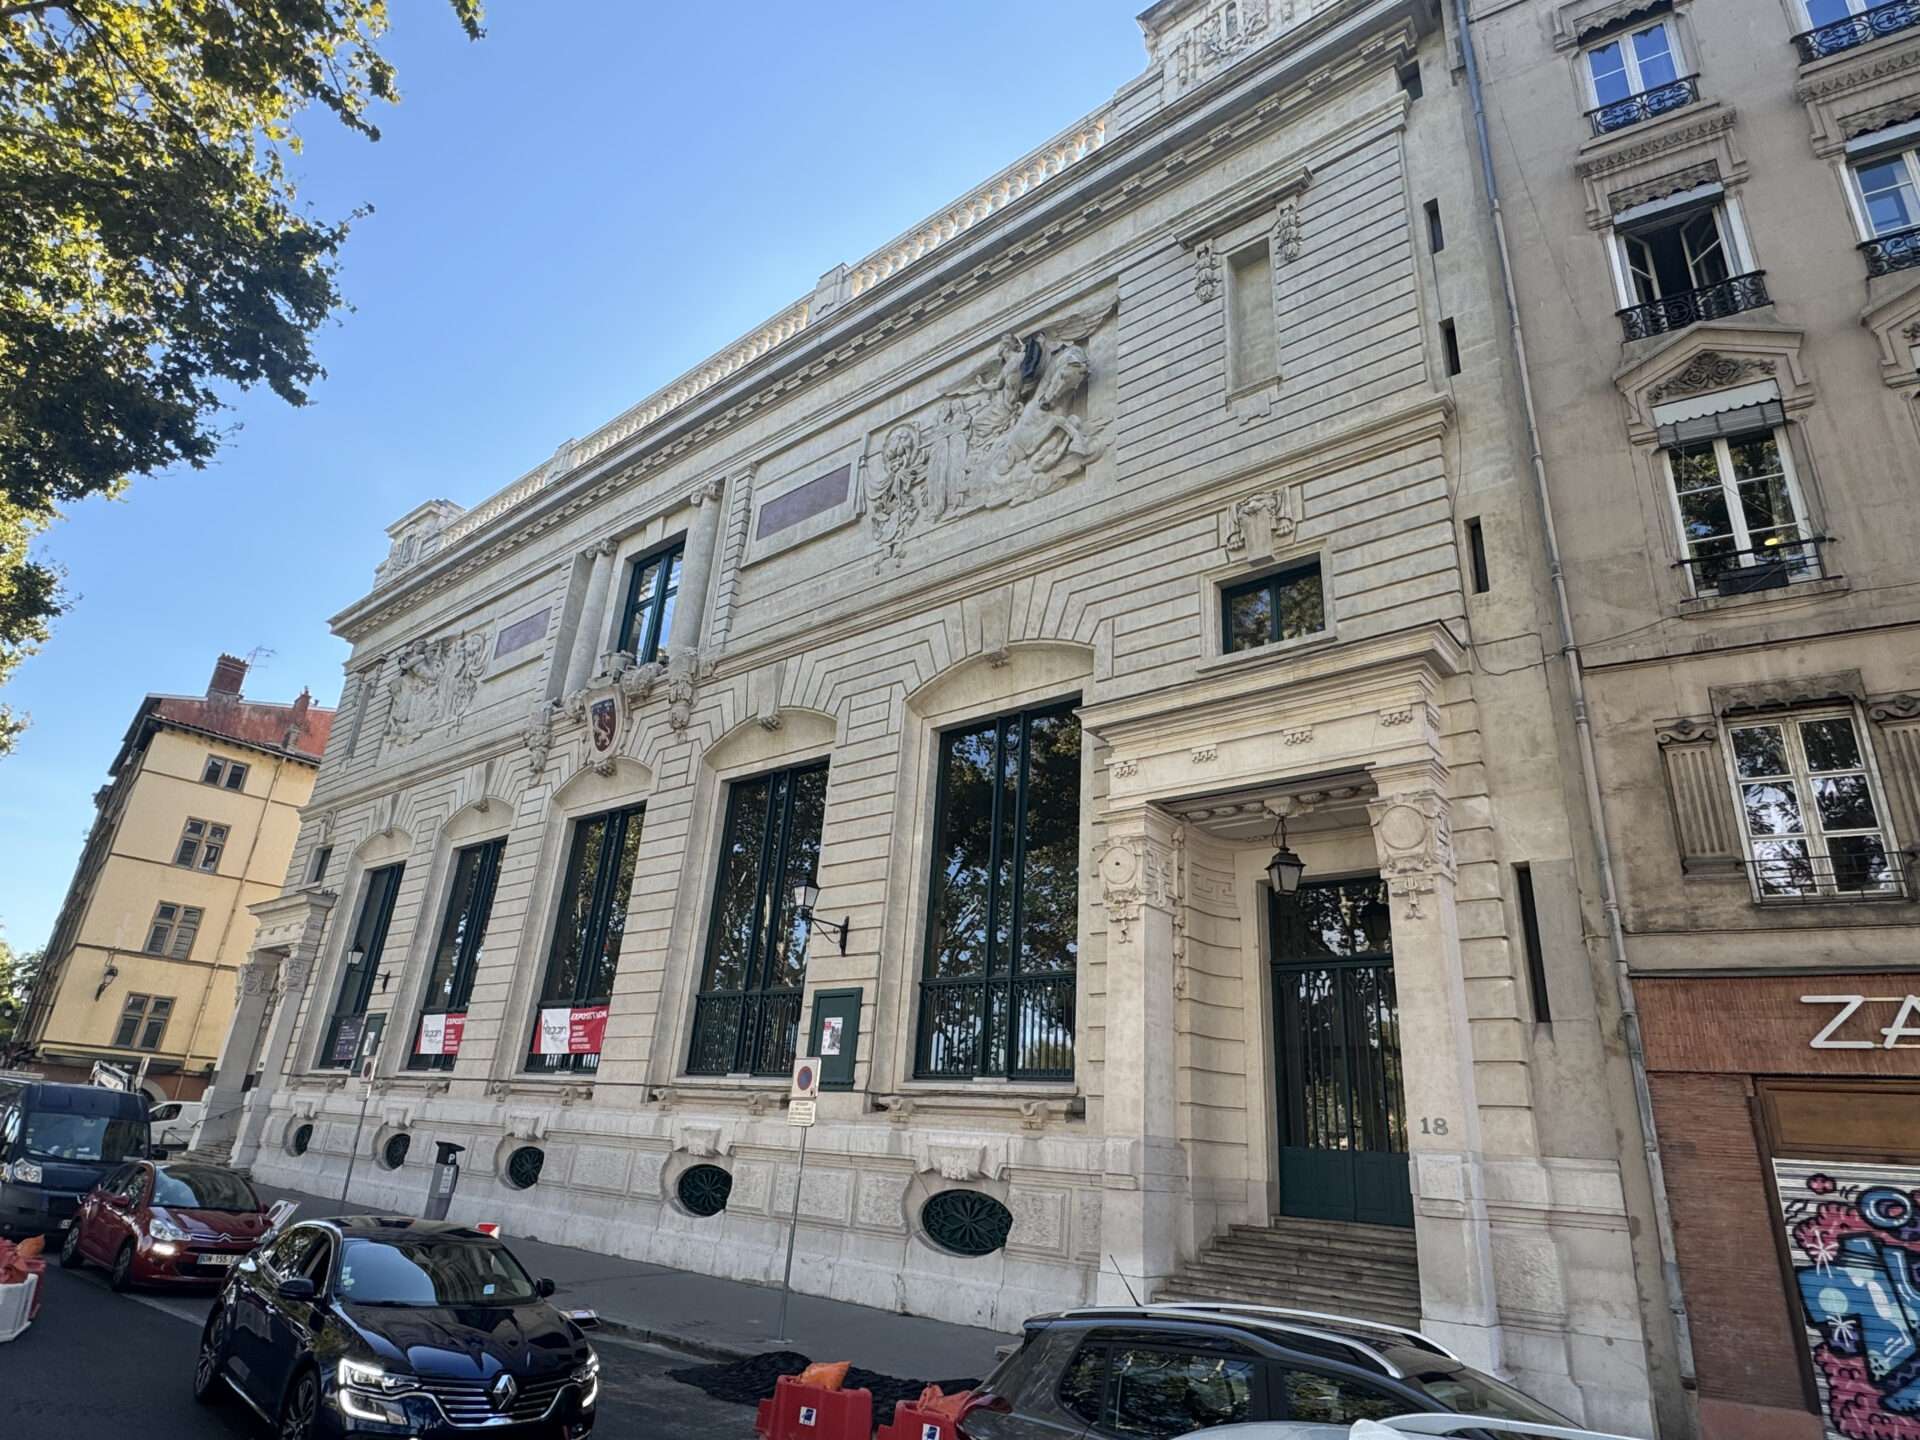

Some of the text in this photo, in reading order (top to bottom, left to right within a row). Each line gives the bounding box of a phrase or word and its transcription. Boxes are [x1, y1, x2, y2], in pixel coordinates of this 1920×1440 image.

[570, 1010, 608, 1021] EXPOSITION
[1420, 1117, 1449, 1136] 18
[447, 1153, 456, 1164] P
